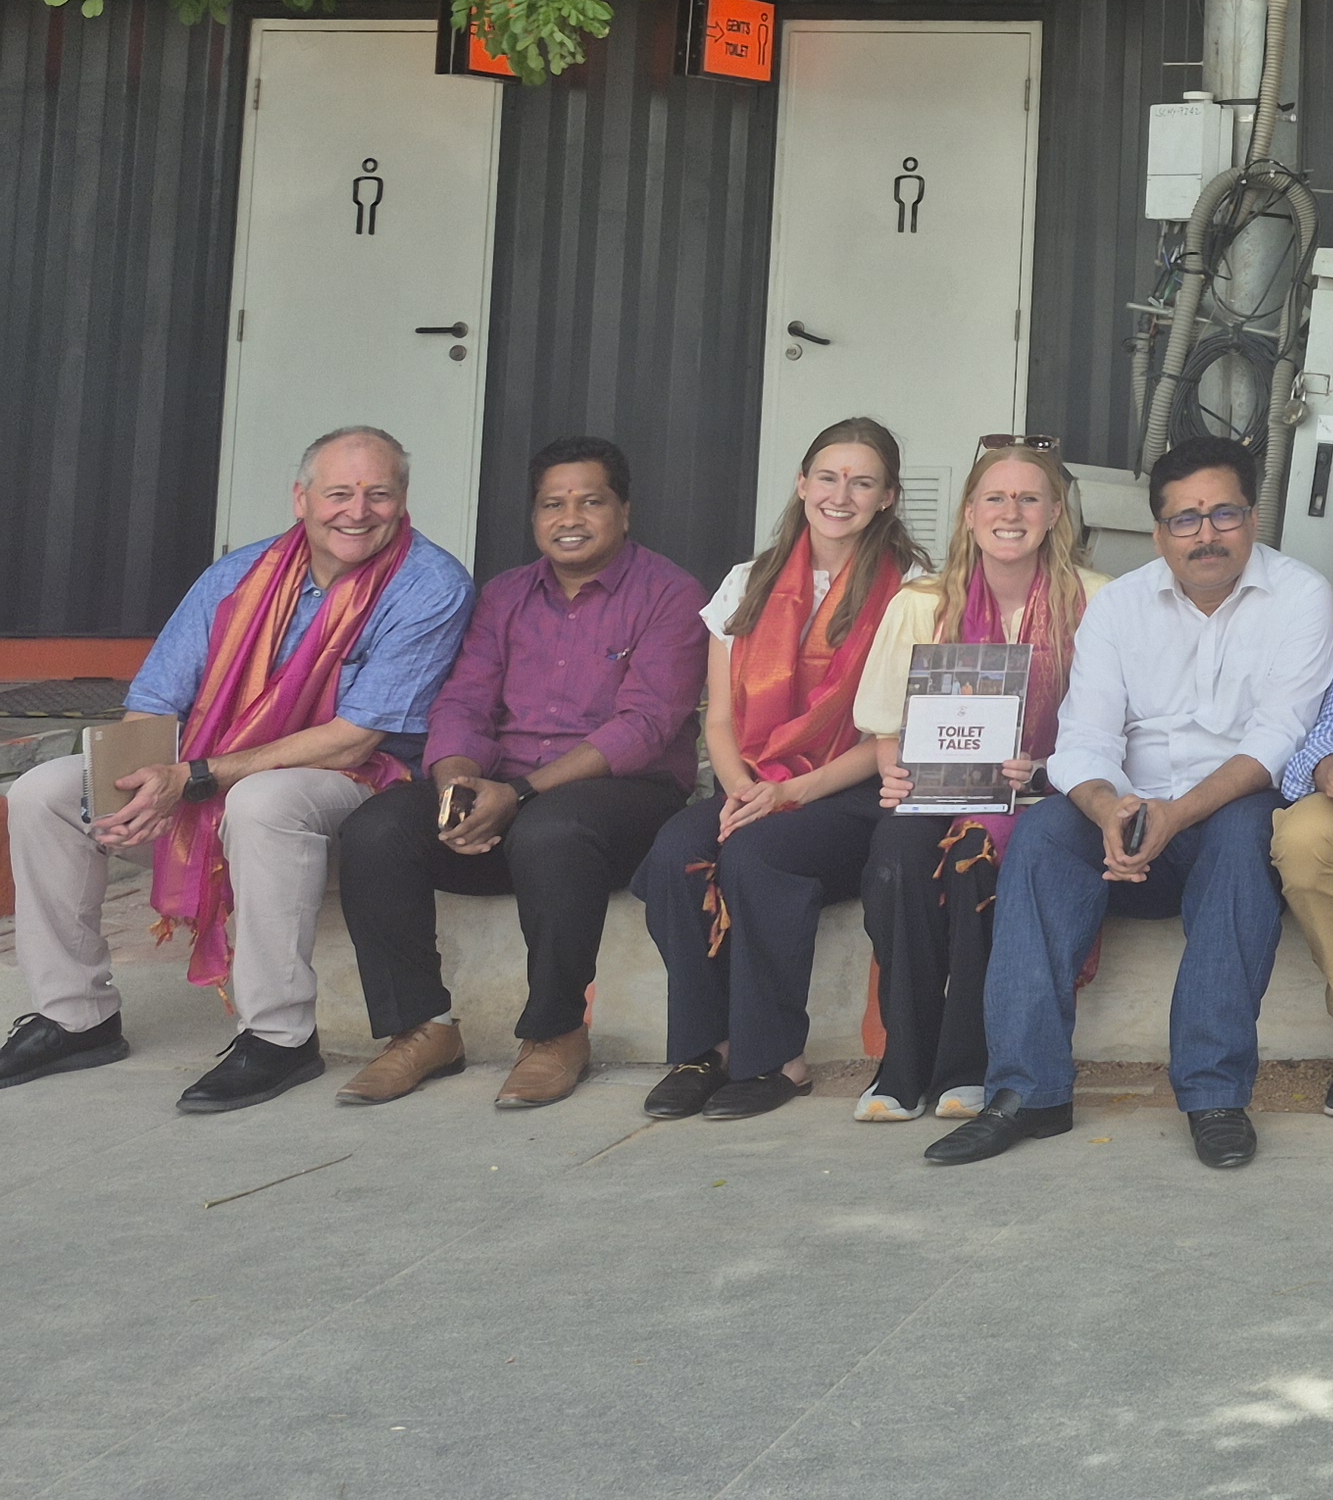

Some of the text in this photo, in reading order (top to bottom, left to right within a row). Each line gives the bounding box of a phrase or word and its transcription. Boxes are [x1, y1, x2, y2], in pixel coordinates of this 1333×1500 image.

[724, 41, 749, 58] TOILET
[937, 726, 985, 738] TOILET
[938, 739, 981, 750] TALES
